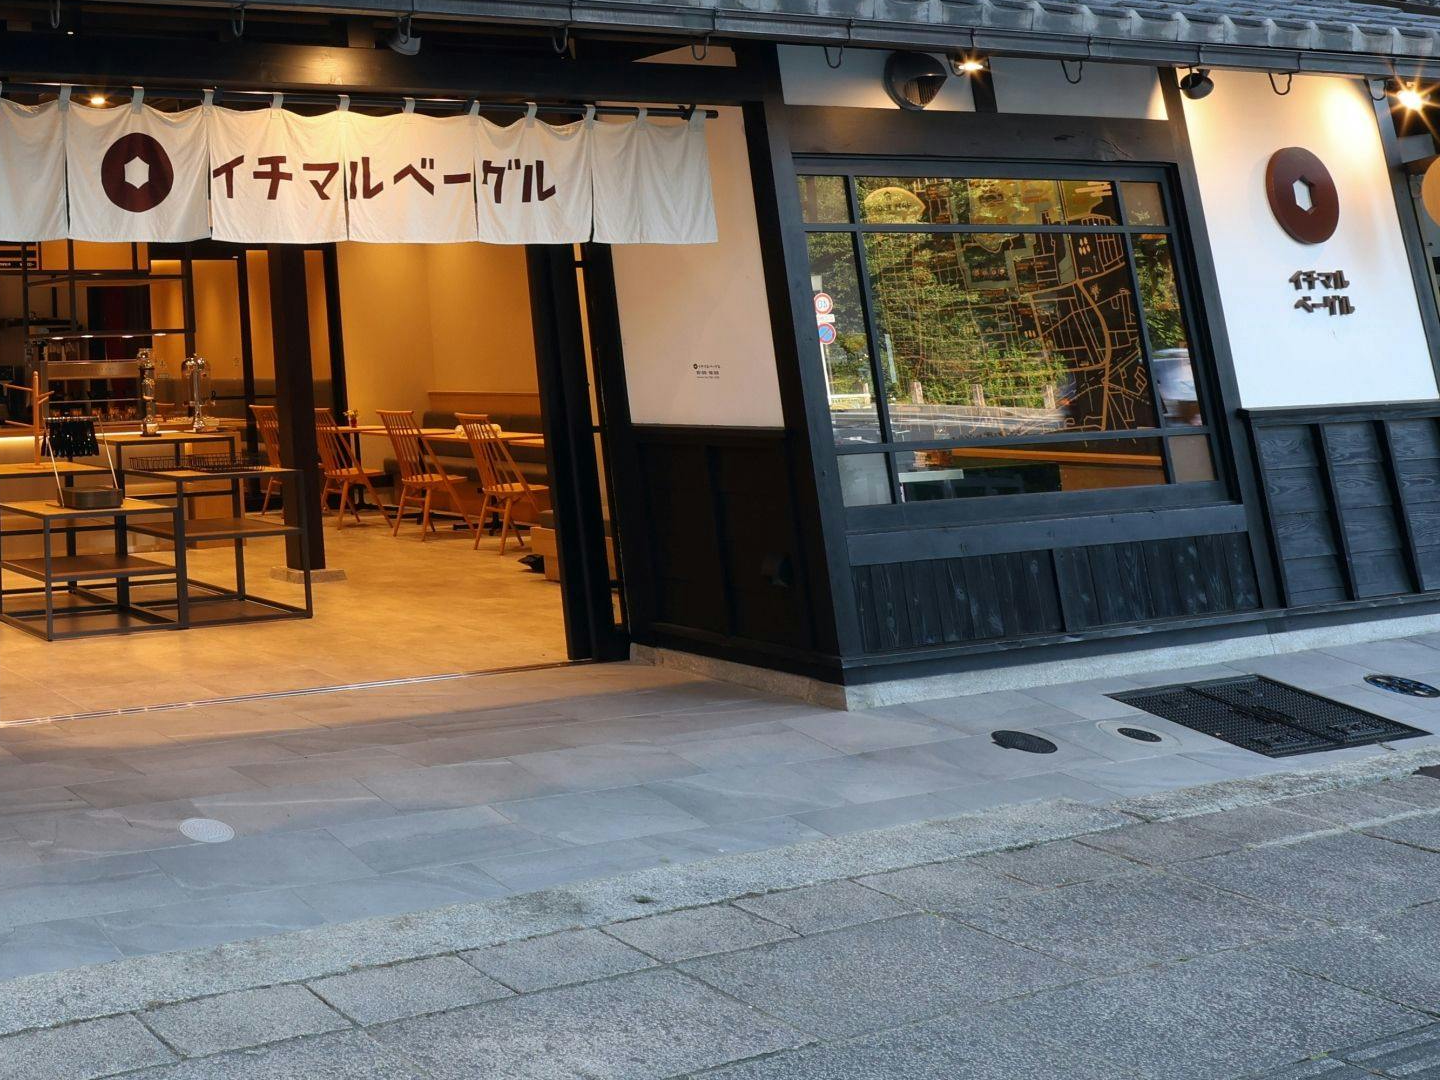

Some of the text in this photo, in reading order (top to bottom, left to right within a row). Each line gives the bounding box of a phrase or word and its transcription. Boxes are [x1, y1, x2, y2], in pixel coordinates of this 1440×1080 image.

[212, 154, 556, 204] イチマルベーグル
[1289, 270, 1350, 290] イチマル
[1294, 295, 1355, 316] ベーグル
